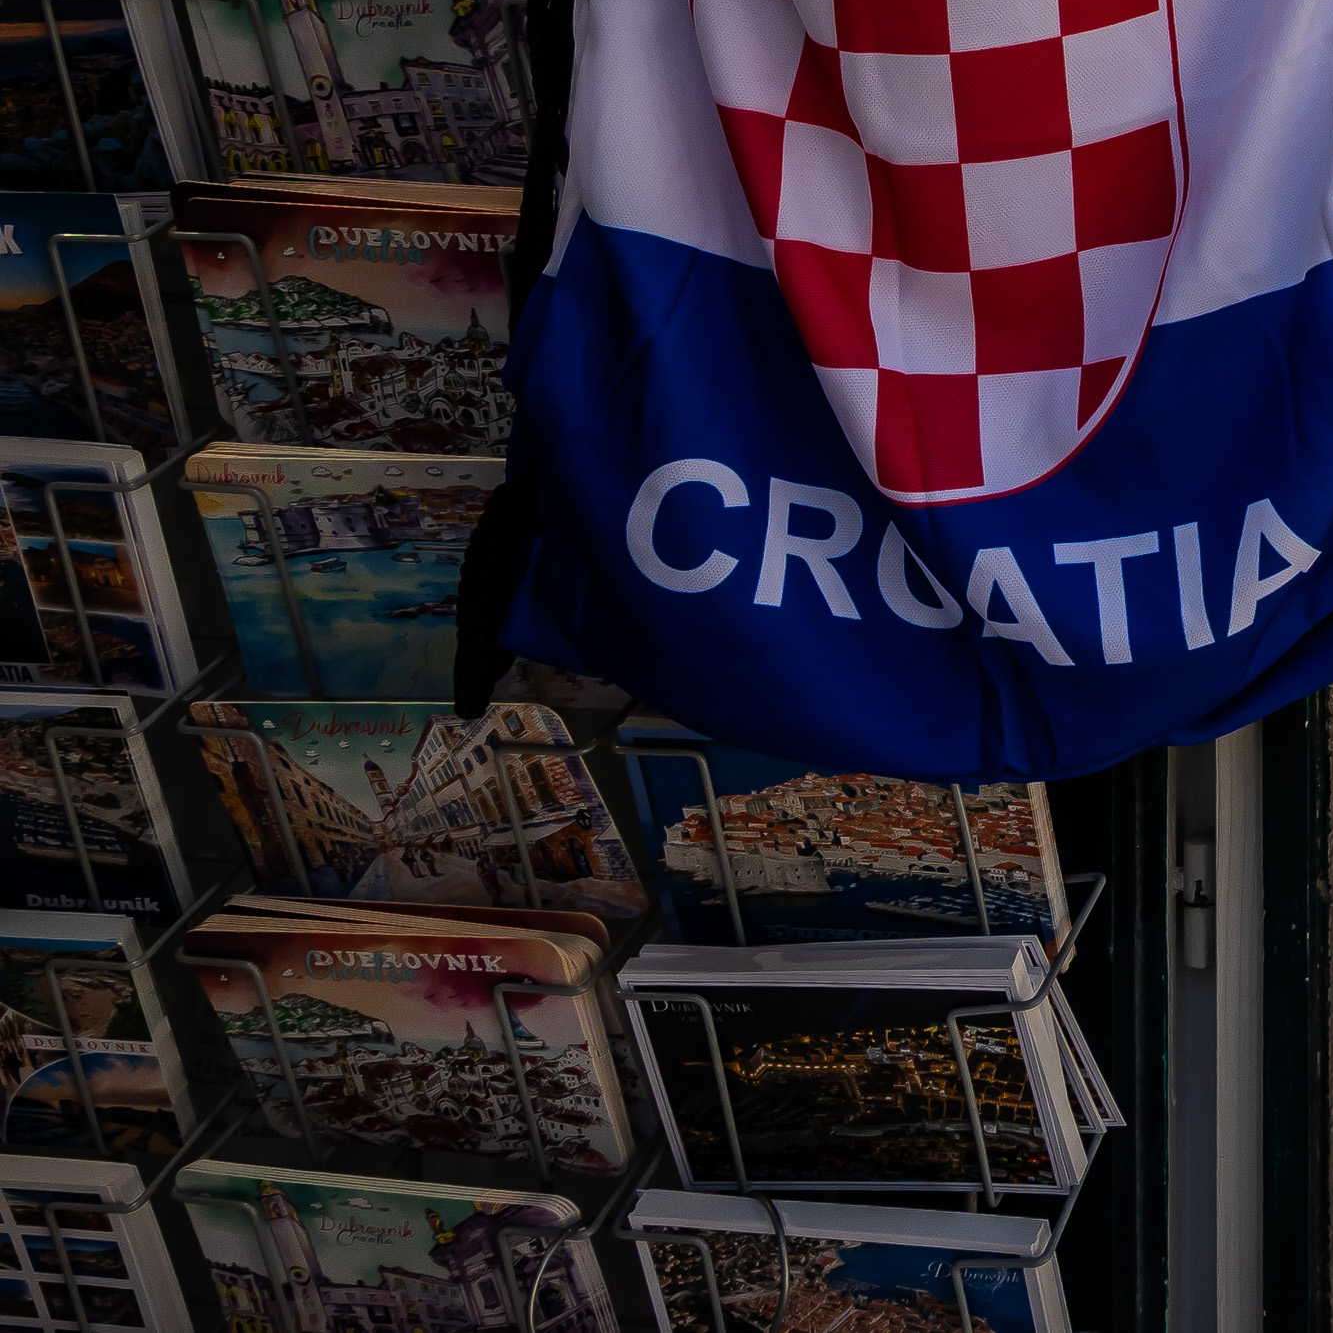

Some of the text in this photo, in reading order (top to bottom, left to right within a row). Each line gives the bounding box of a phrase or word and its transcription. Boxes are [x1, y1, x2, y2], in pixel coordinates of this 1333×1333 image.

[356, 13, 413, 38] Croatia
[194, 461, 289, 485] Dubrovnik
[627, 458, 1322, 666] CROATIA
[280, 711, 416, 742] Dubrovnik
[25, 893, 161, 912] Dubrvnik
[651, 1000, 753, 1013] DUBRVNIK
[33, 1037, 149, 1054] DUROVNIK
[320, 1213, 415, 1239] Dubrovnik
[921, 1261, 1021, 1284] Dbrovnik
